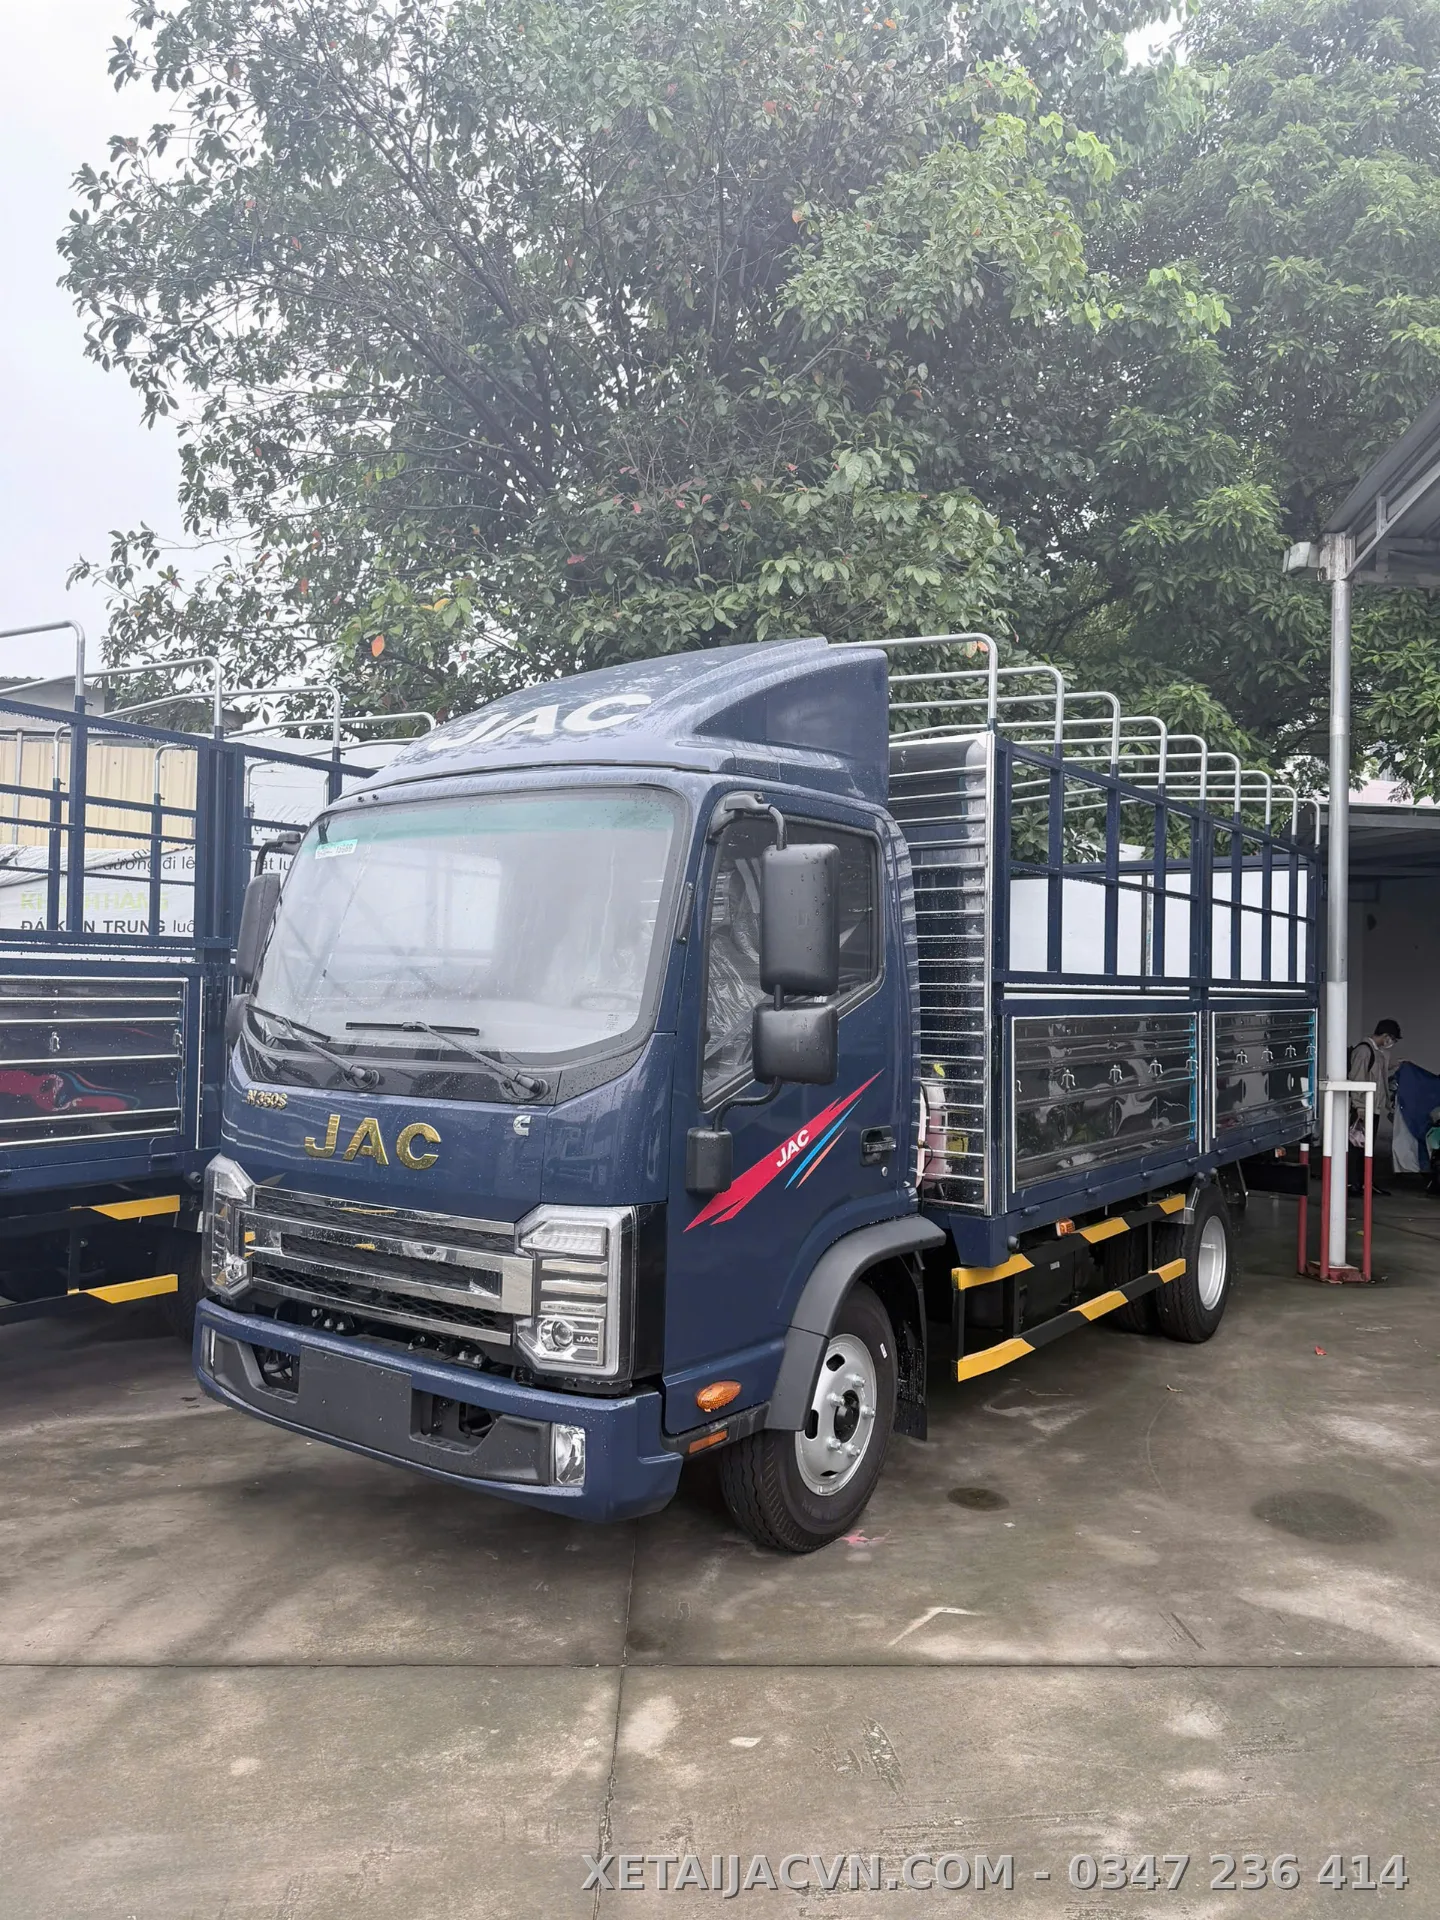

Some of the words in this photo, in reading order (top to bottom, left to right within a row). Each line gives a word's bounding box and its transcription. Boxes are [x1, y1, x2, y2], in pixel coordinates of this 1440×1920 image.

[428, 694, 652, 751] JAC
[162, 856, 177, 870] đi
[103, 920, 166, 934] TRUNG
[304, 1113, 442, 1170] JAC
[776, 1129, 810, 1167] JAC
[576, 1335, 598, 1344] JAC
